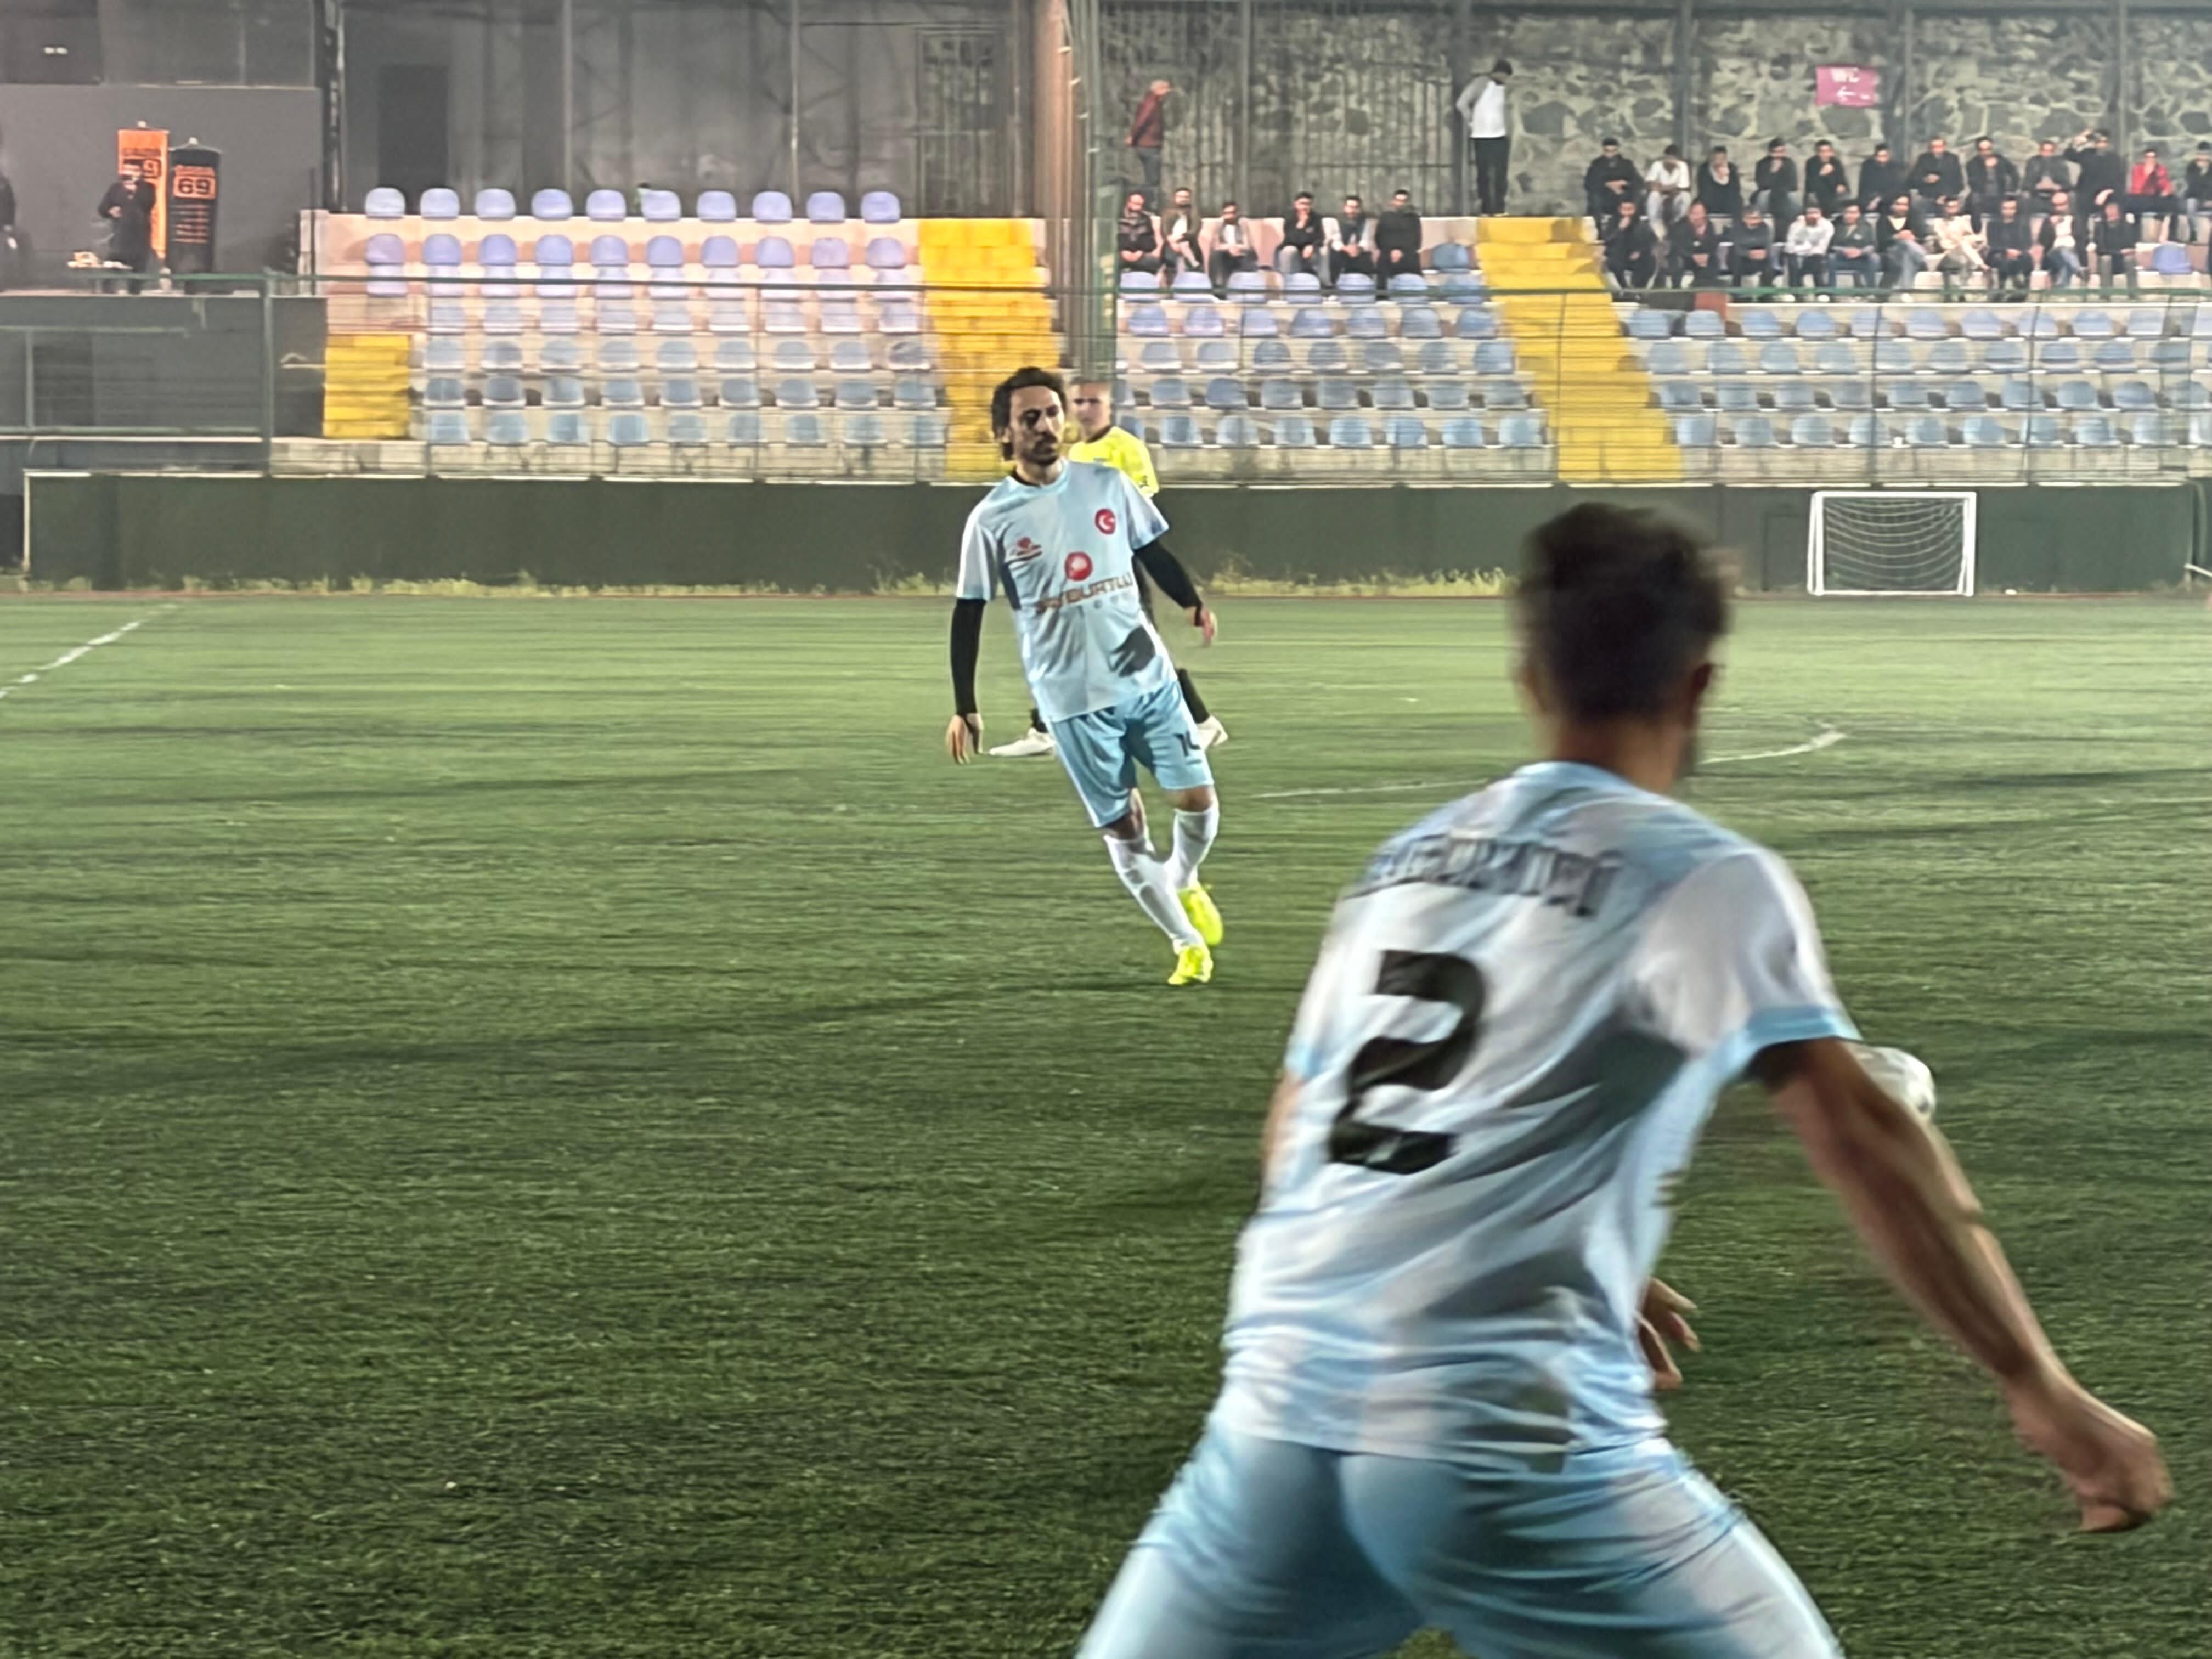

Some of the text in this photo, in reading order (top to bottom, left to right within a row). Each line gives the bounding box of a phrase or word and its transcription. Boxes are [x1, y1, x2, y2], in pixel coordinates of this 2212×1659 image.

[1831, 67, 1860, 82] WC
[178, 178, 211, 195] 69
[1329, 950, 1485, 1175] 2
